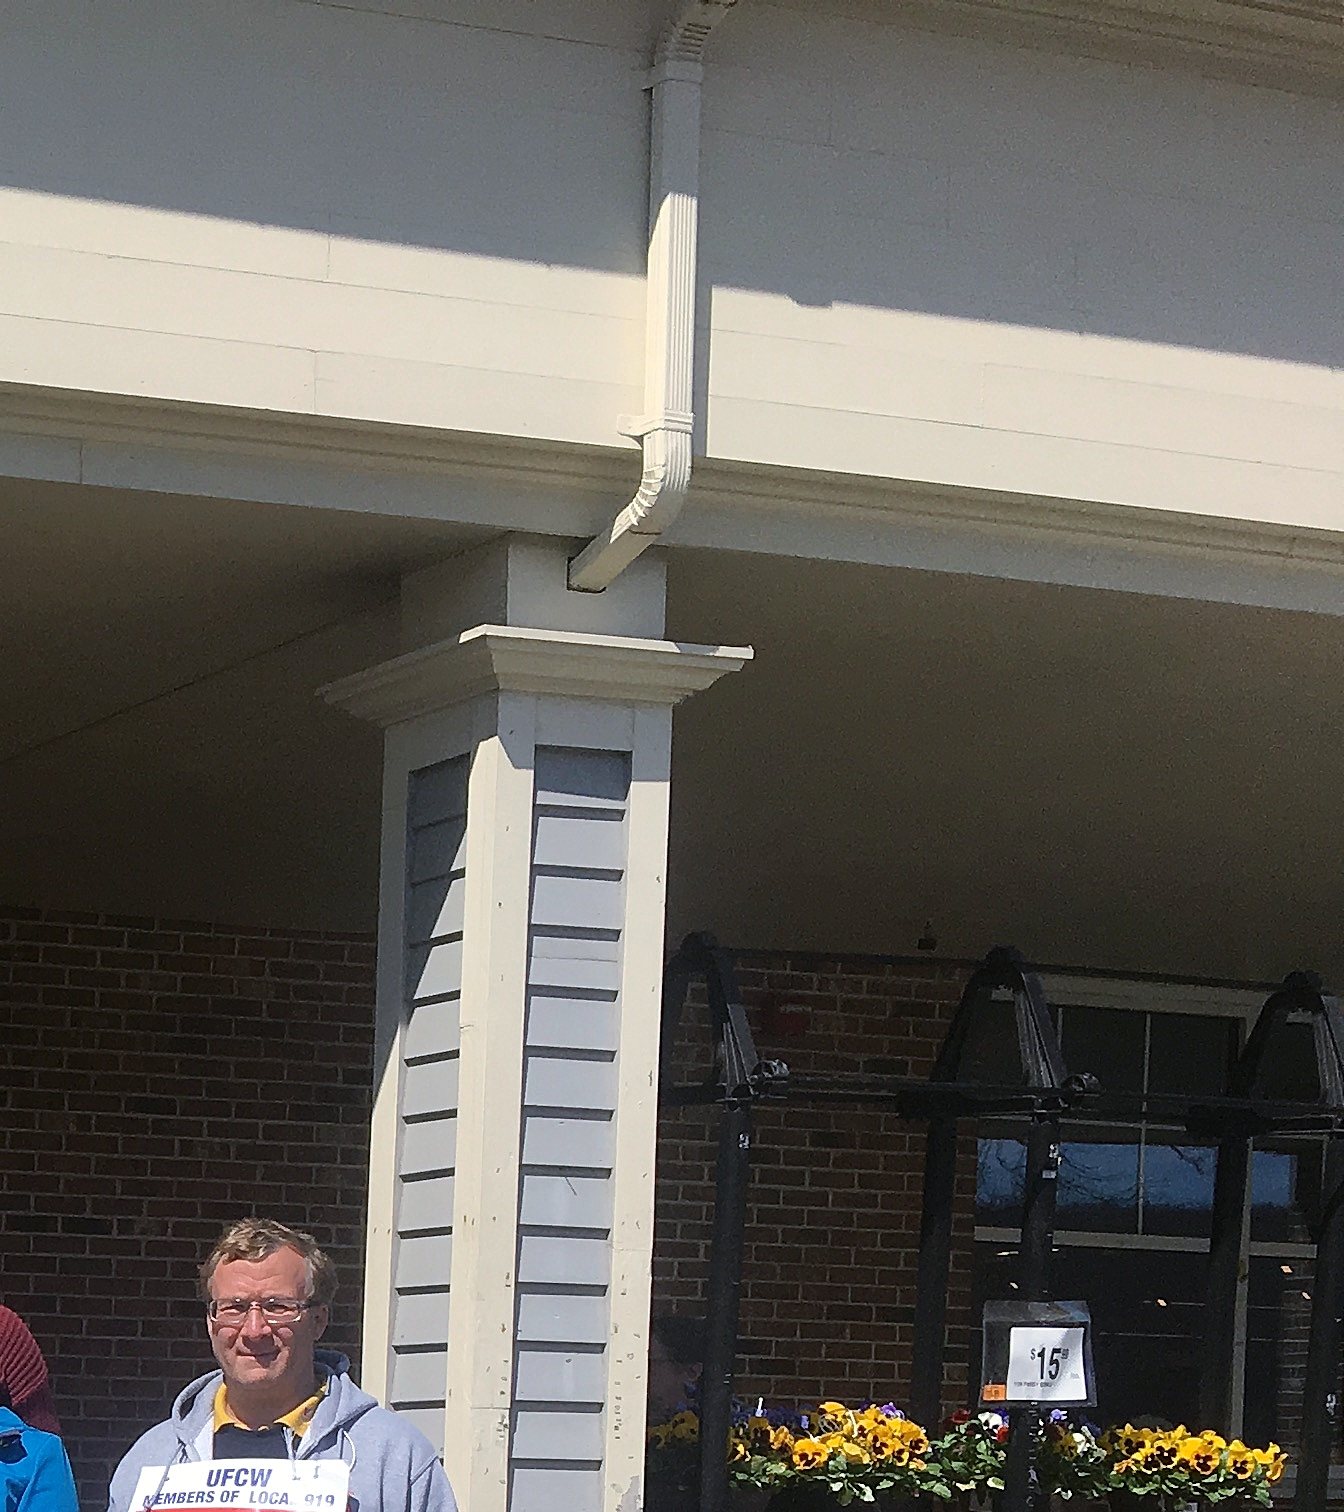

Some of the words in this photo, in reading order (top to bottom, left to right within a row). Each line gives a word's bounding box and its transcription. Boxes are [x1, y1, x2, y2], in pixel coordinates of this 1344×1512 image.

[206, 1468, 273, 1487] UFCW
[142, 1491, 215, 1507] MEMBERS
[219, 1490, 241, 1503] OF
